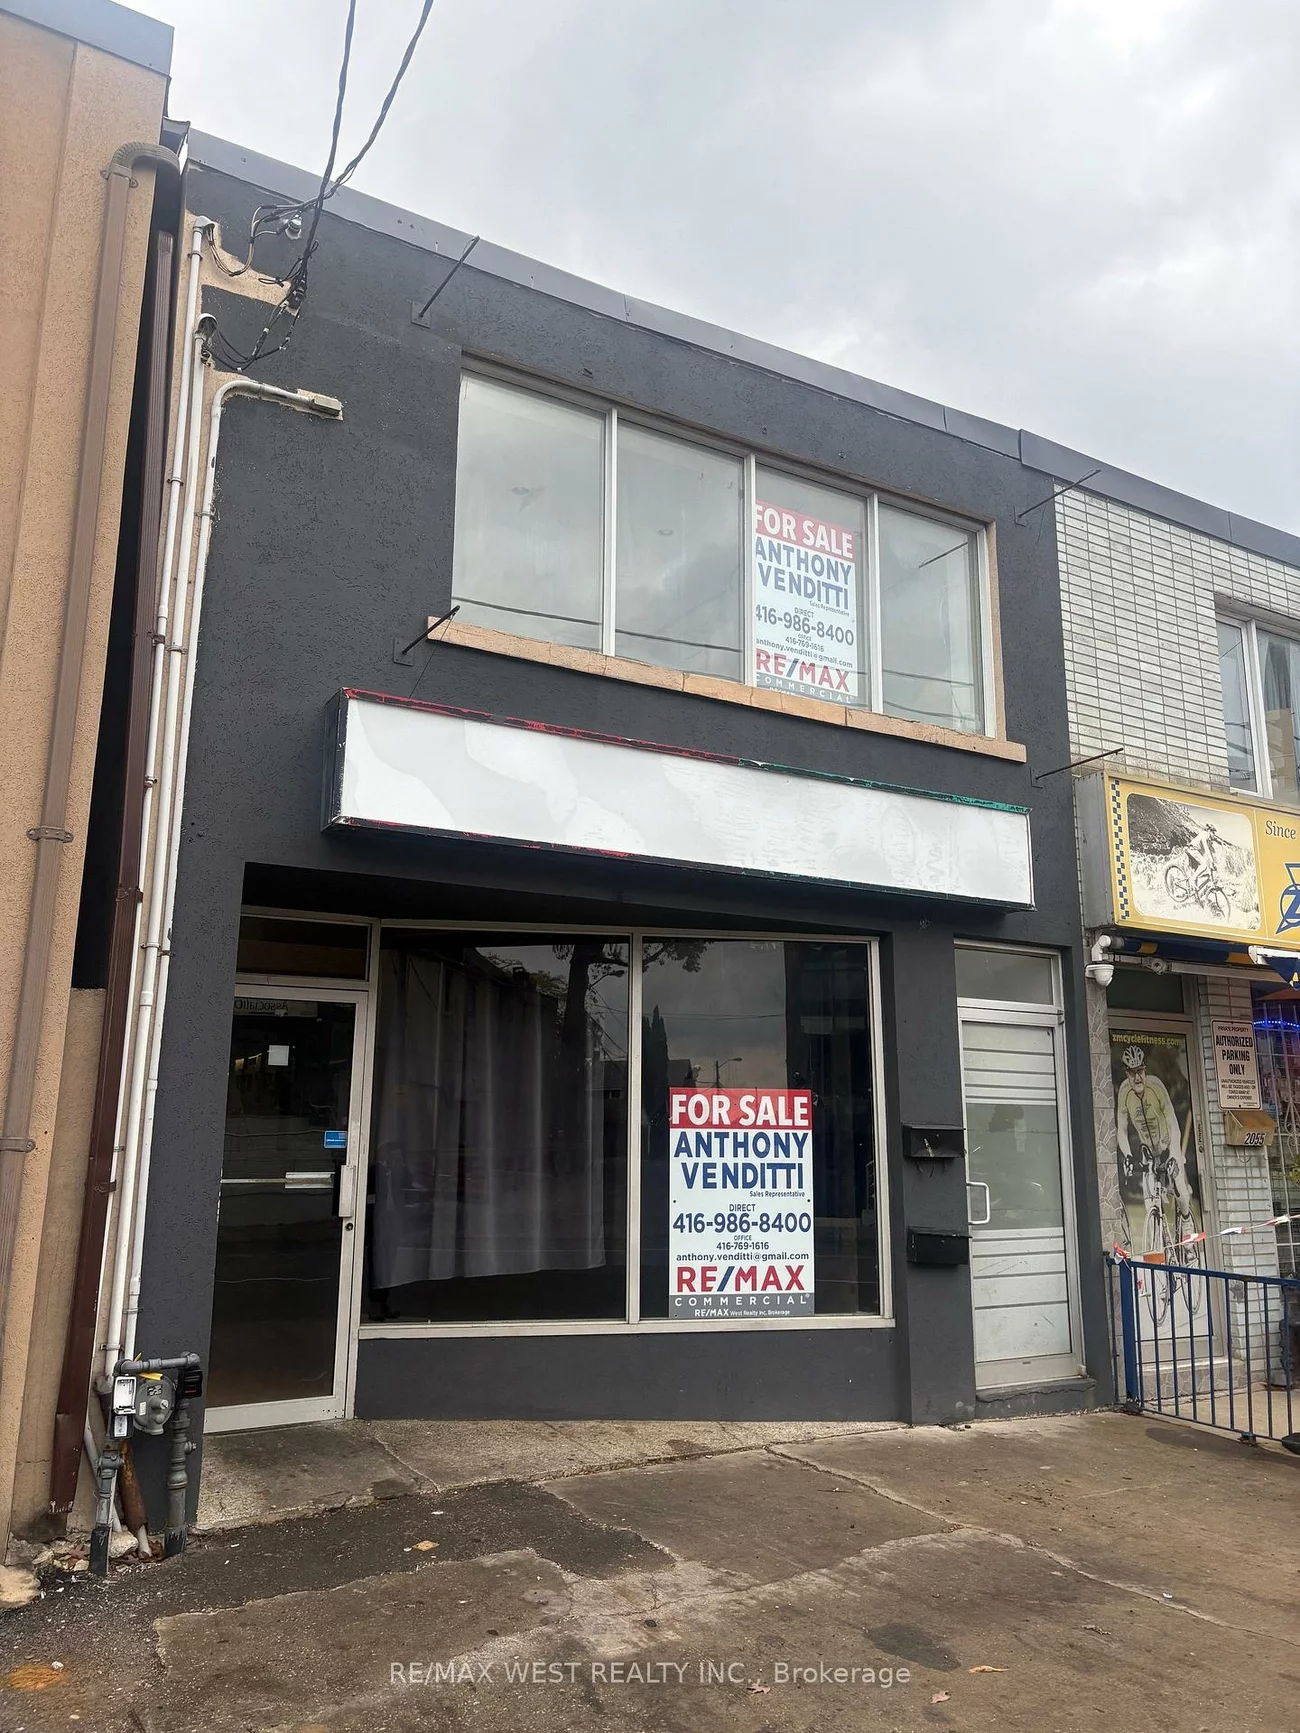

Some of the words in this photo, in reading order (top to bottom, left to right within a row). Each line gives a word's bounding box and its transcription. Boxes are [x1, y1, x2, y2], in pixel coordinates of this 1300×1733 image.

[756, 504, 796, 541] FOR
[802, 519, 854, 559] SALE
[756, 537, 852, 585] ANTHONY
[758, 562, 849, 610] VENDITTI
[794, 607, 815, 618] DIRECT
[756, 604, 854, 646] 416-986-8400
[756, 638, 853, 668] anthony.venditti@gmail.com
[756, 648, 850, 693] RE/MAX
[1265, 820, 1297, 839] Since
[1112, 1033, 1181, 1046] zmcyclefitness.com
[1216, 1035, 1253, 1047] AUTHORIZED
[1222, 1050, 1250, 1061] PARKING
[1229, 1064, 1245, 1075] ONLY
[672, 1094, 731, 1126] FOR
[739, 1095, 809, 1127] SALE
[674, 1131, 808, 1159] ANTHONY
[1244, 1132, 1265, 1145] 2055
[681, 1162, 803, 1190] VENDITTI
[729, 1204, 756, 1212] DIRECT
[672, 1212, 812, 1233] 416-986-8400
[716, 1241, 769, 1250] 416-769-1616
[676, 1251, 809, 1262] anthony.venditti@gmail.com
[676, 1265, 805, 1293] RE/MAX
[674, 1296, 807, 1307] COMMERCIAL
[694, 1308, 729, 1317] RE/MAX
